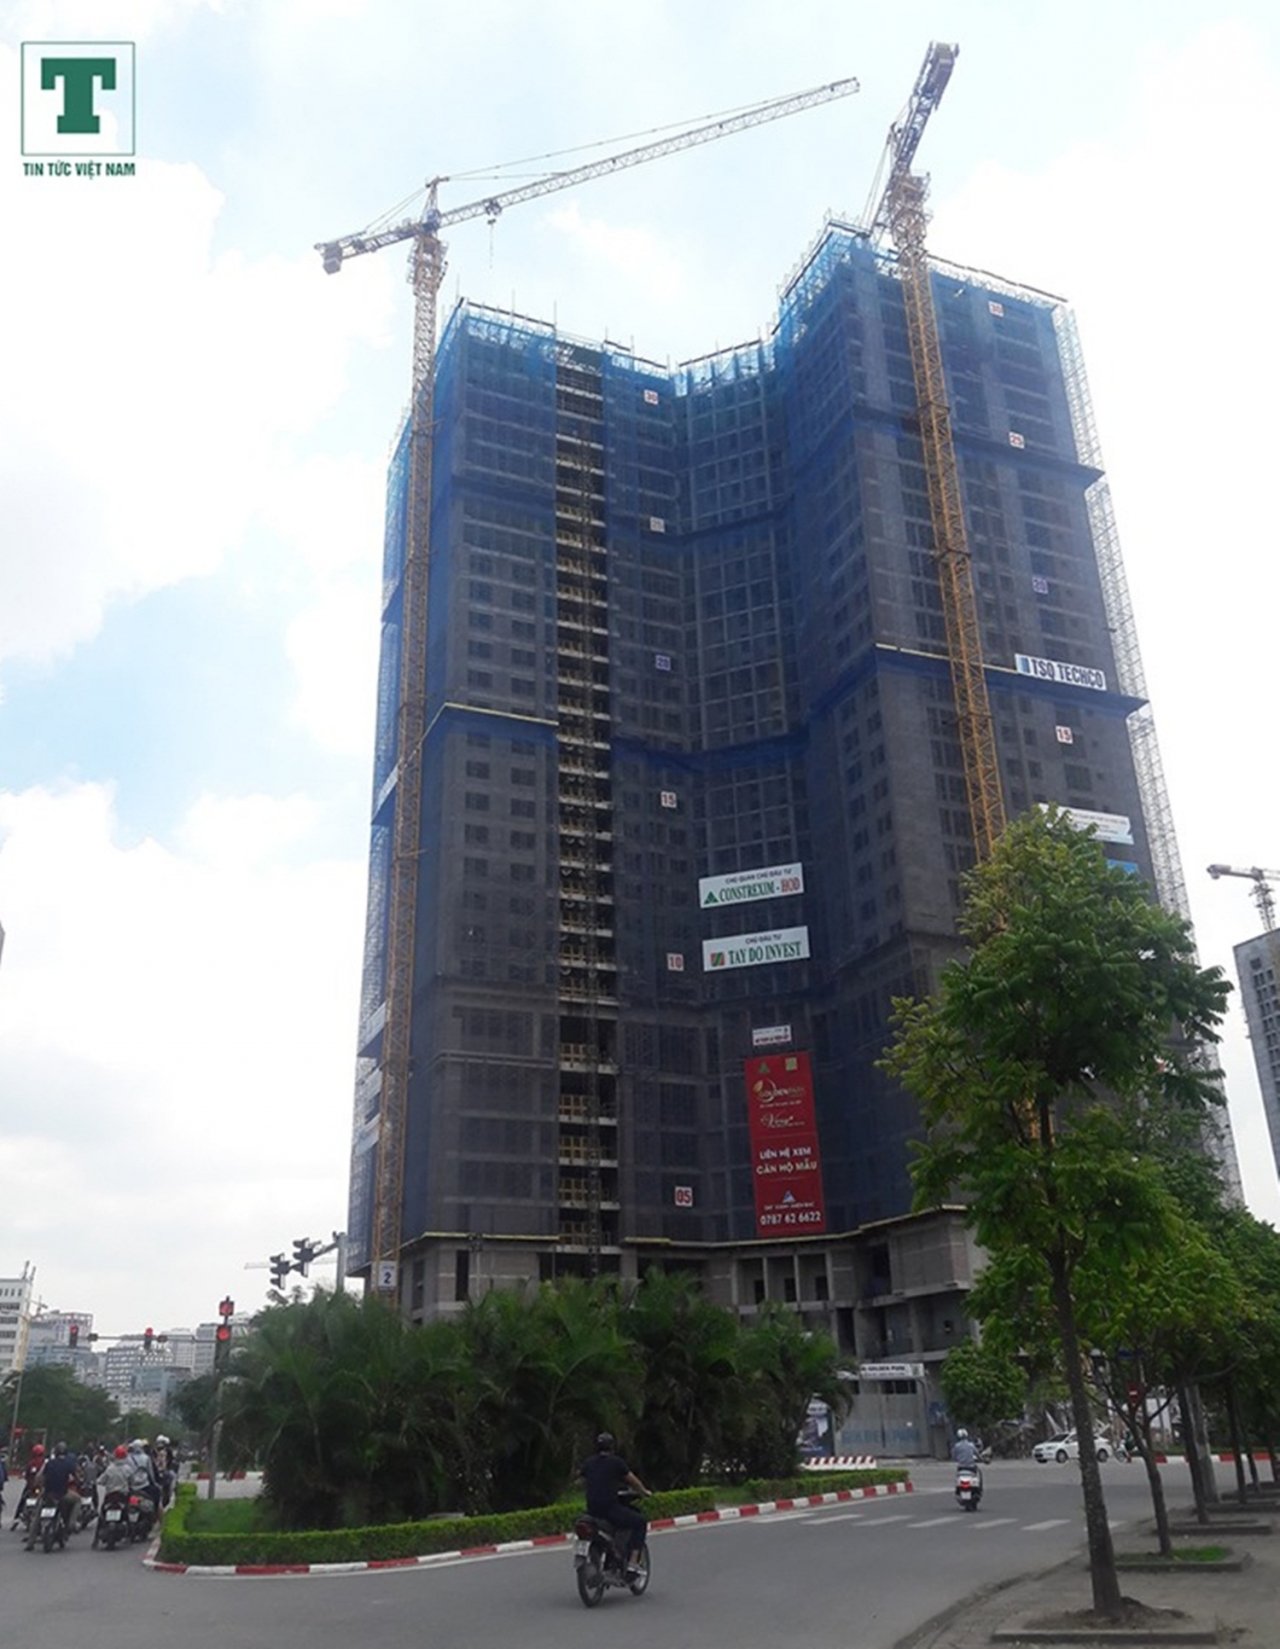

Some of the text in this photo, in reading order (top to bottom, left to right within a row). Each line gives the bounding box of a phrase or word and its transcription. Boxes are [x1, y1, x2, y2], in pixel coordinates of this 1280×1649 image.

[1031, 659, 1104, 688] TSQ TECHCO
[1058, 728, 1072, 741] 15
[728, 941, 801, 965] TAY DO INVEST
[670, 956, 682, 969] 10
[792, 1147, 812, 1157] XEM
[677, 1189, 690, 1204] 05
[384, 1271, 392, 1285] 2
